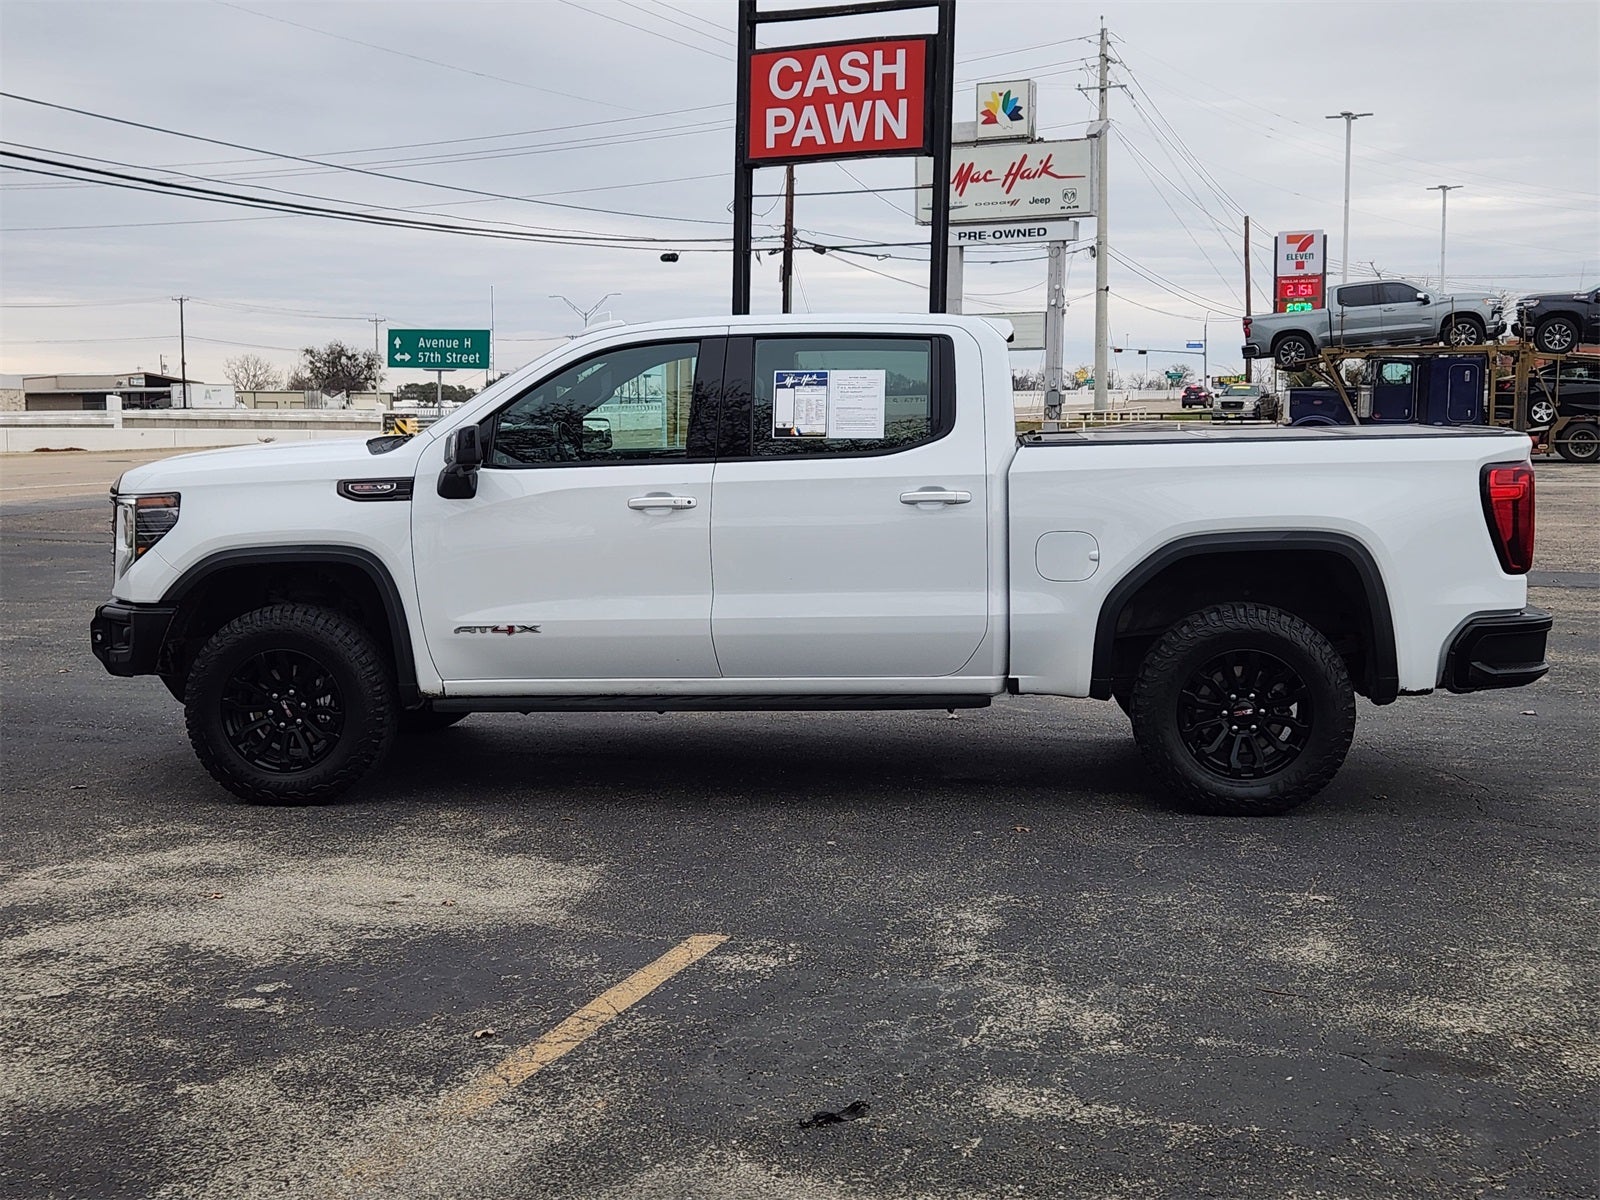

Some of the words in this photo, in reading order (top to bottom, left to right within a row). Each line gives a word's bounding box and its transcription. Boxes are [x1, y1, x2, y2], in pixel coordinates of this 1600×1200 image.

[768, 48, 906, 99] CASH
[765, 98, 908, 149] PAWN
[950, 161, 1001, 197] Mac
[1001, 153, 1086, 195] Haik
[1028, 196, 1051, 205] Jeep
[957, 227, 1048, 241] PRE-OWNED
[418, 337, 459, 349] Avenue
[464, 338, 471, 348] H
[418, 352, 441, 363] 57th
[446, 352, 480, 363] Street
